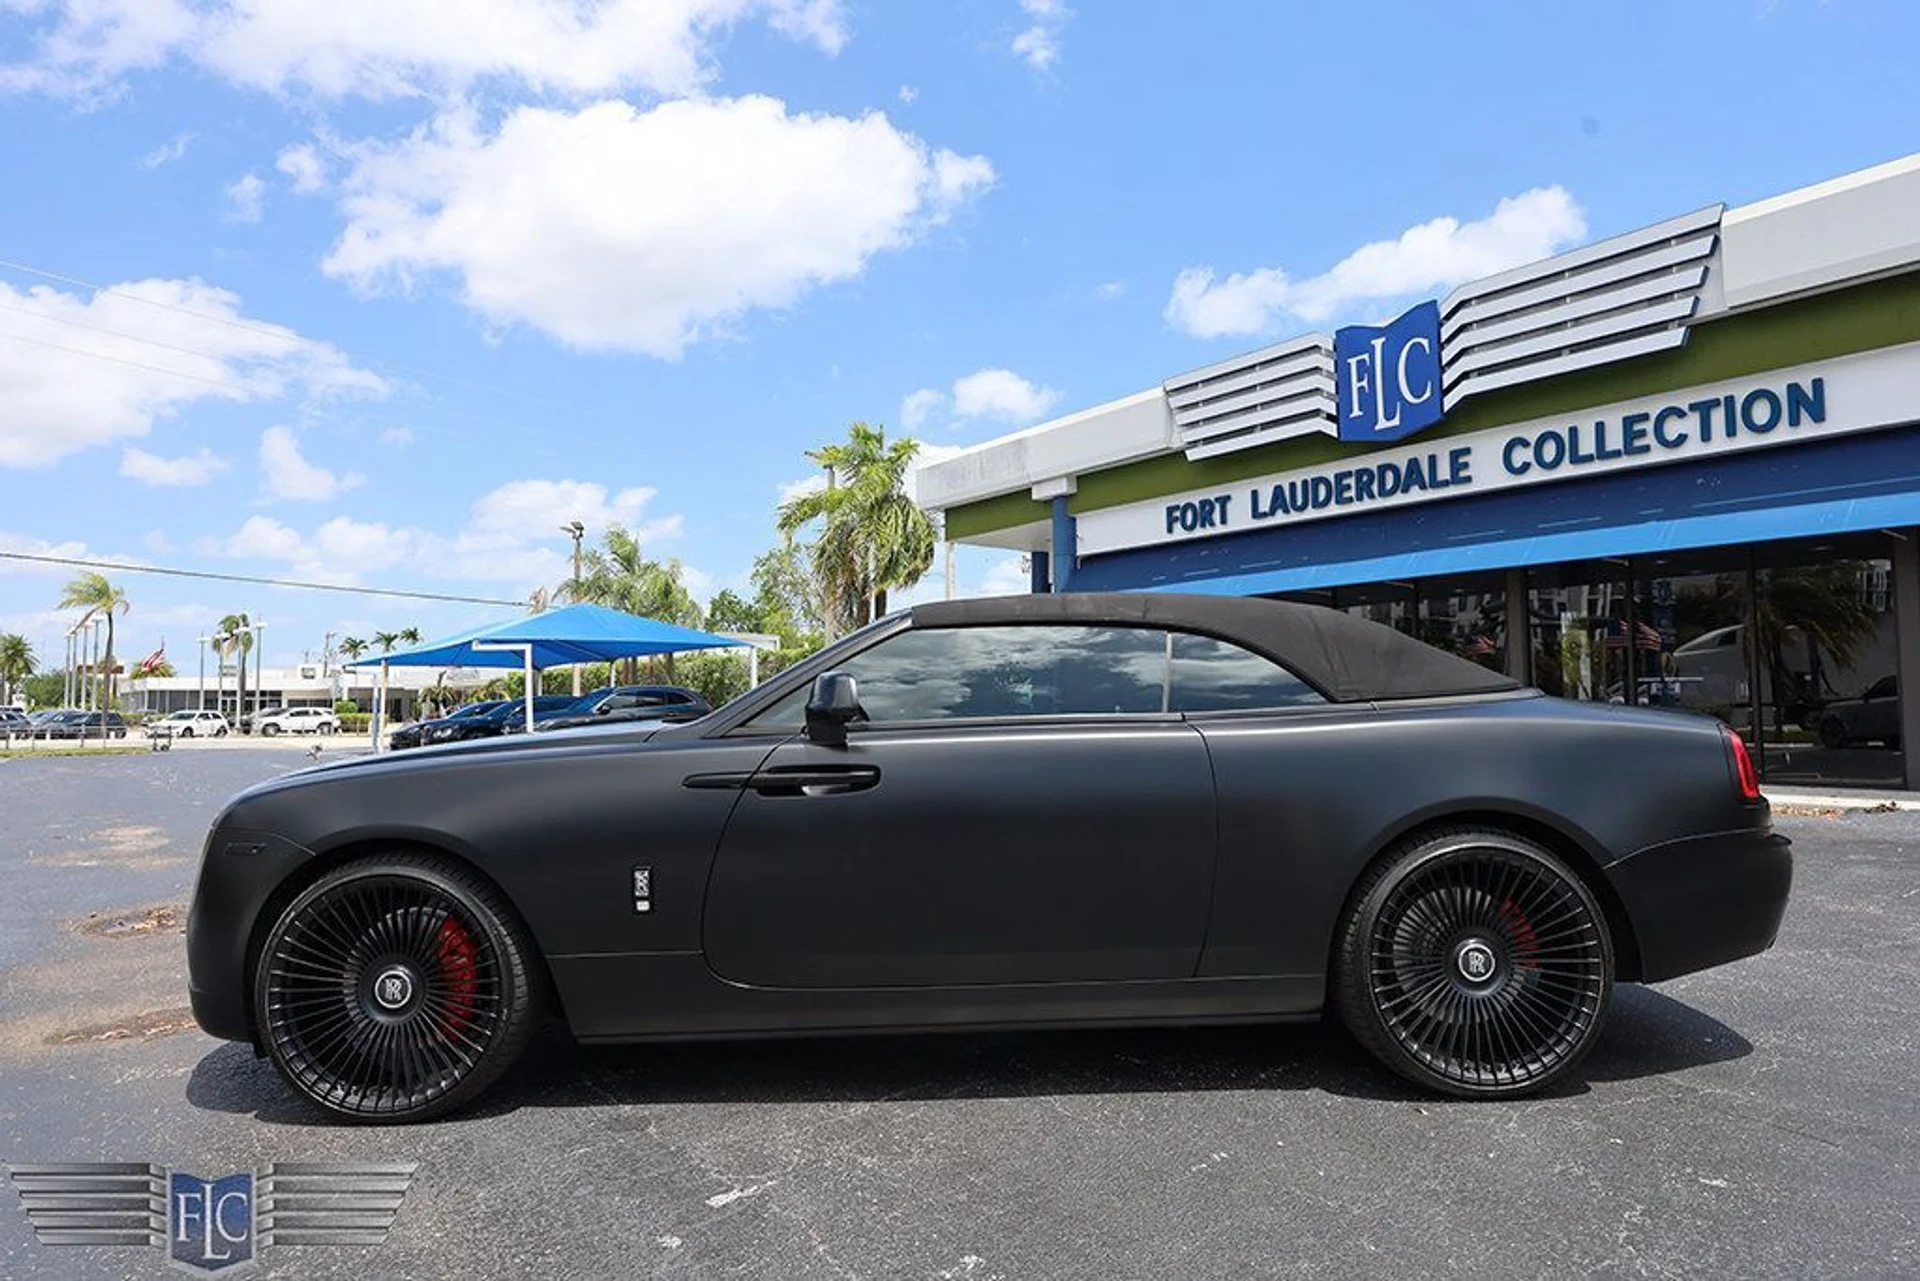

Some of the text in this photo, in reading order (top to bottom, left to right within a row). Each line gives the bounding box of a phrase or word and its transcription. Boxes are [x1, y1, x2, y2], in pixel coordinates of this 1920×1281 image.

[1346, 337, 1432, 431] FLC
[1166, 377, 1827, 535] FORT LAUDERDALE COLLECTION
